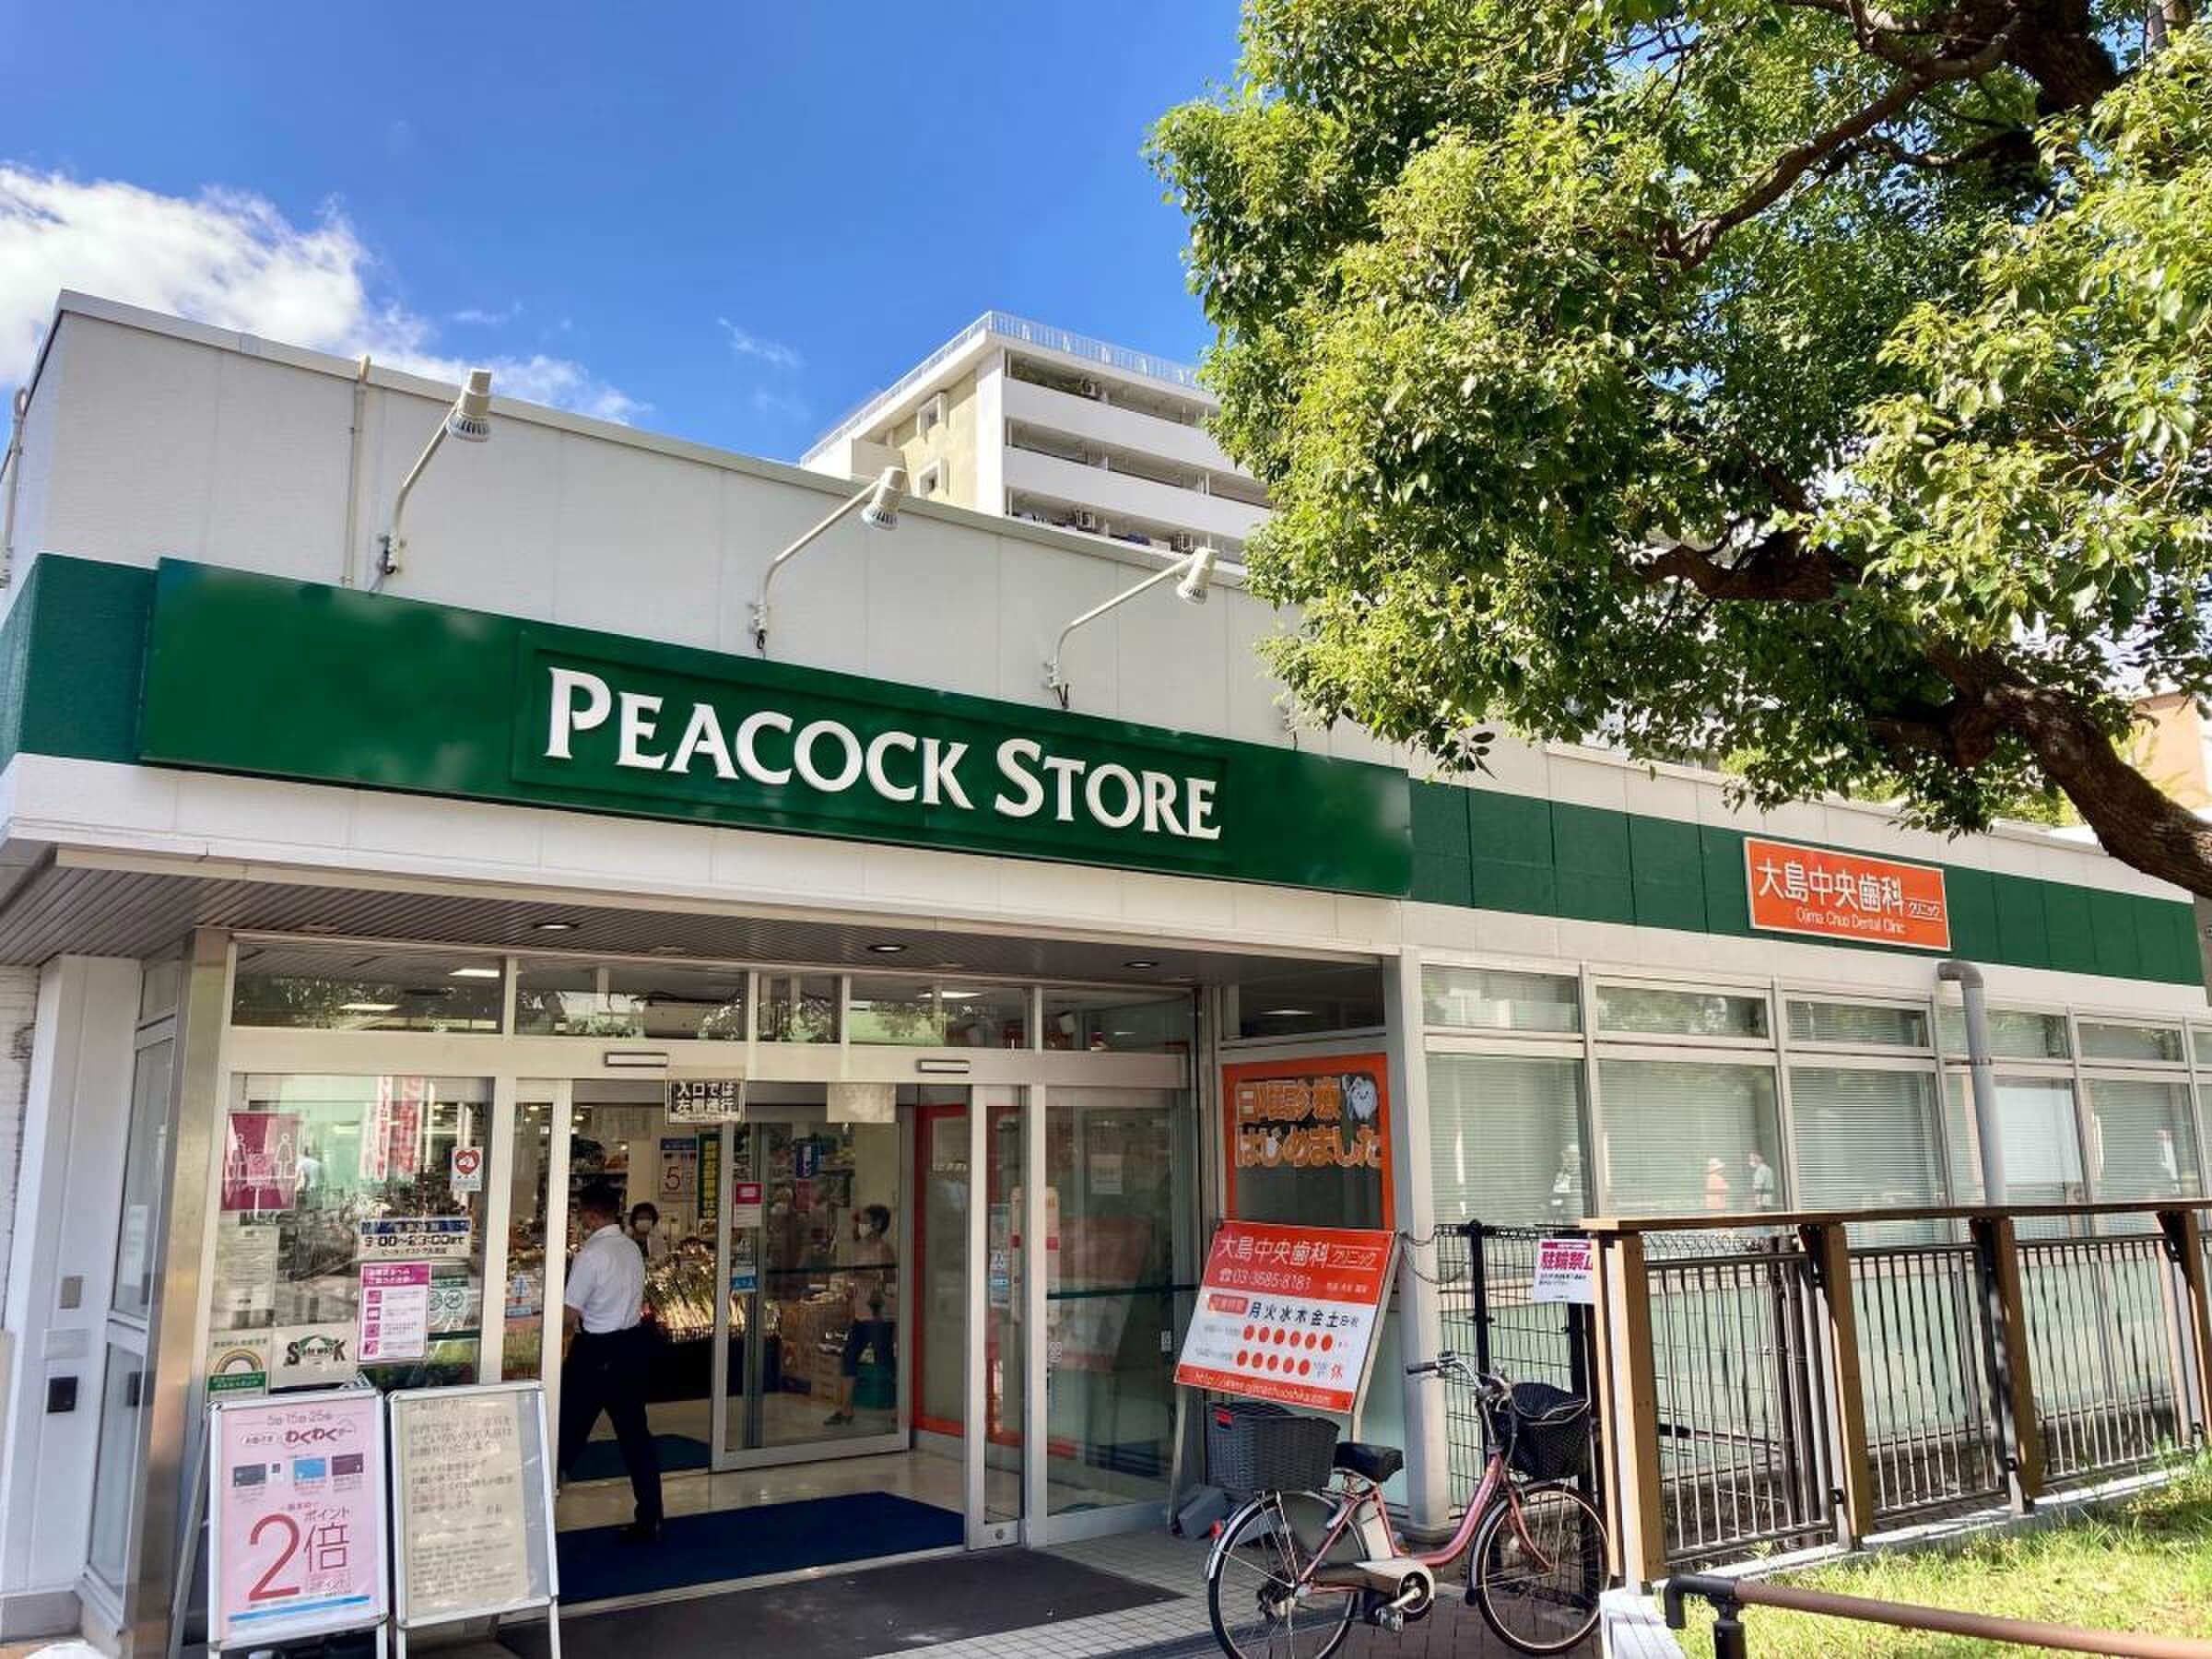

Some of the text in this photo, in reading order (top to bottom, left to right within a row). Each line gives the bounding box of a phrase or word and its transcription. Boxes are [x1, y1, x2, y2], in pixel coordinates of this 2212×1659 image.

[544, 666, 1222, 841] PEACOCK STORE
[1758, 858, 1903, 916] 大島中央歯科
[677, 1081, 736, 1098] 入口では
[1216, 1234, 1328, 1269] 大島中央歯科
[304, 1505, 351, 1522] ポイント
